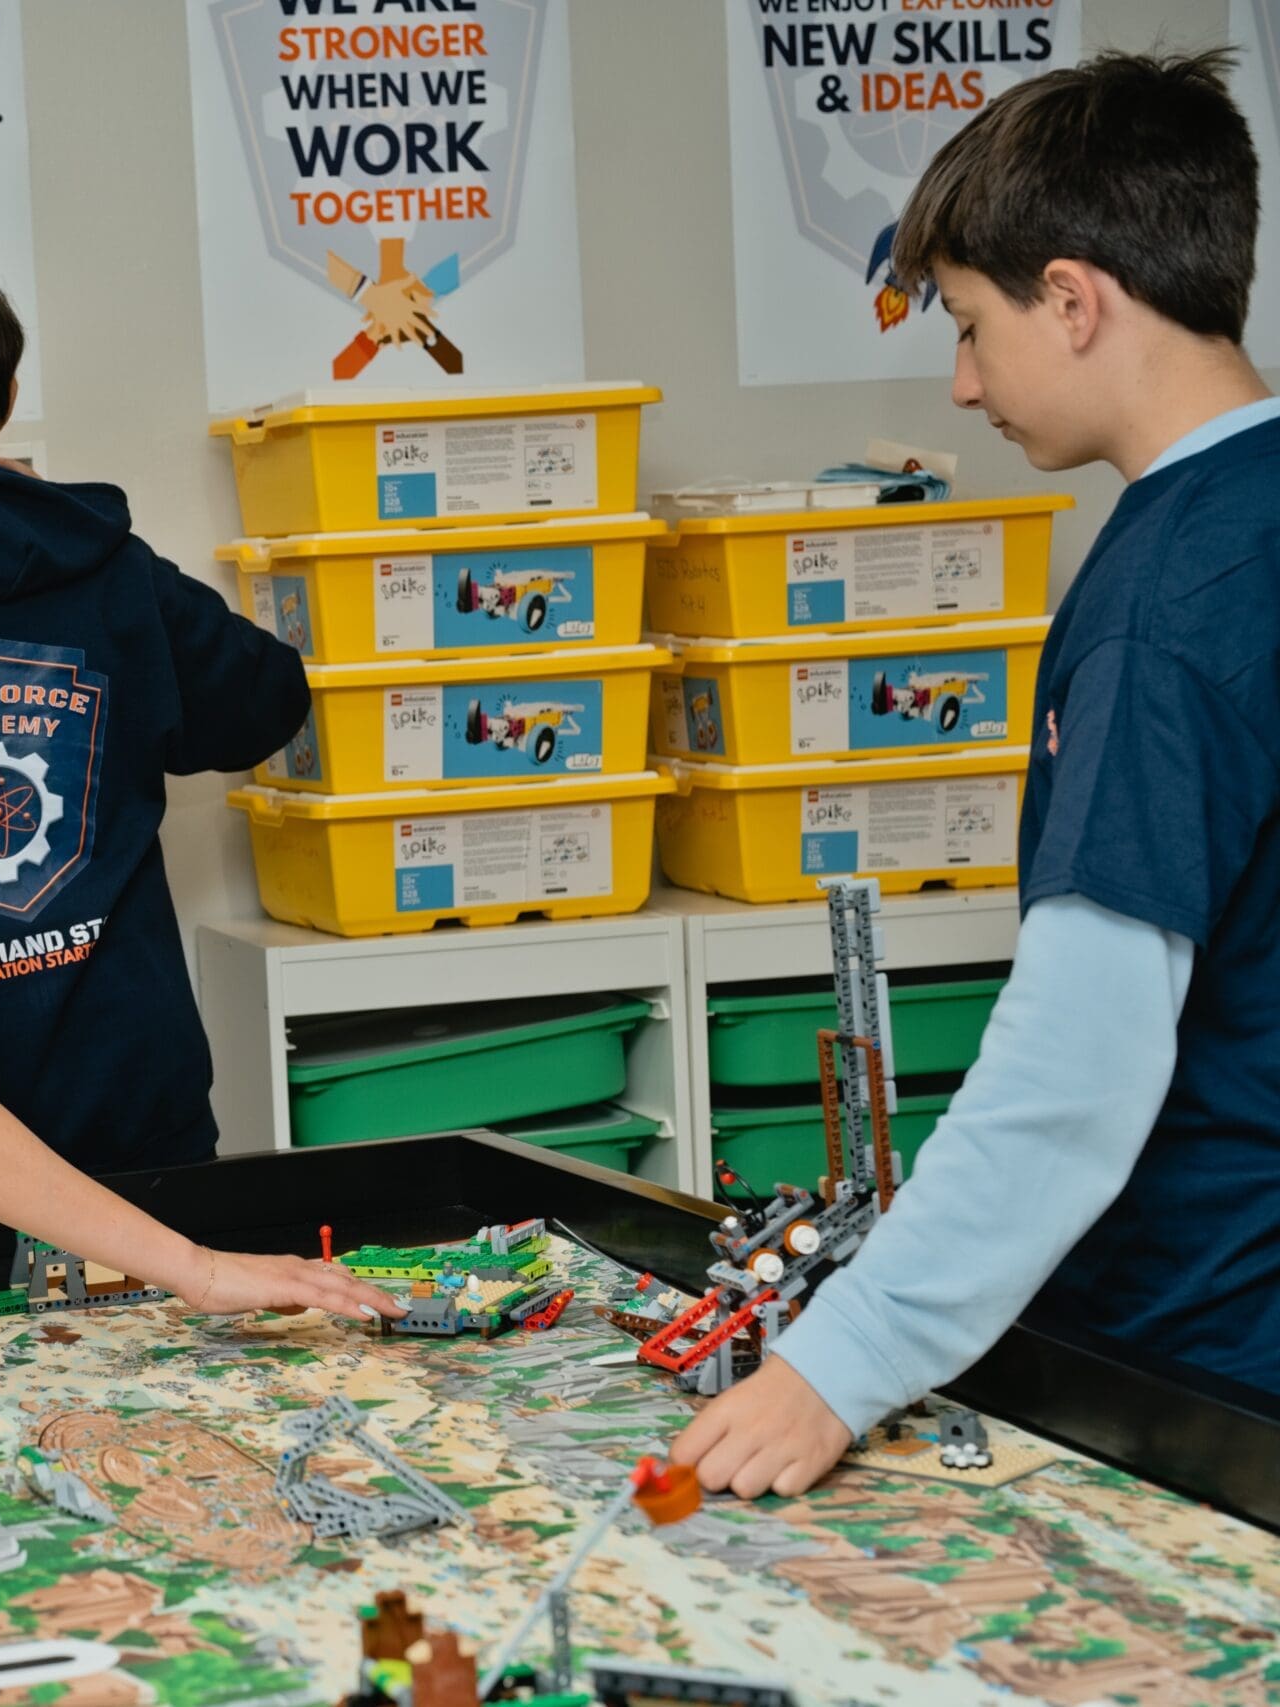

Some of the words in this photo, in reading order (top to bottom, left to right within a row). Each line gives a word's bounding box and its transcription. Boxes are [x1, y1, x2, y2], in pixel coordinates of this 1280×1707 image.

[278, 23, 488, 62] STRONGER
[763, 22, 877, 67] NEW
[892, 18, 1052, 65] SKILLS
[280, 71, 410, 111] WHEN
[421, 69, 488, 107] WE
[816, 74, 851, 113] &
[861, 70, 985, 112] IDEAS
[286, 121, 490, 178] WORK
[290, 186, 491, 226] TOGETHER
[70, 916, 108, 945] ST
[46, 943, 96, 968] START
